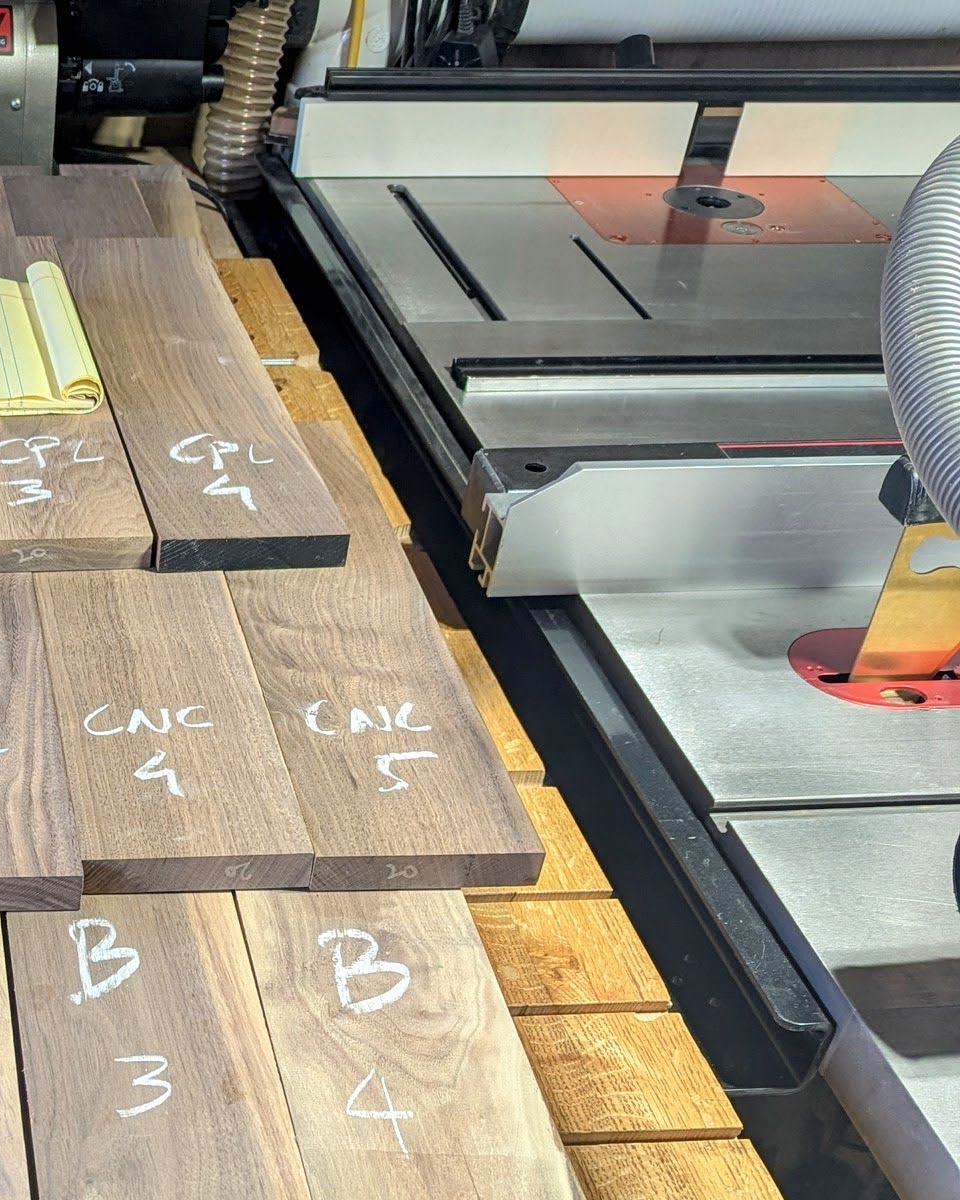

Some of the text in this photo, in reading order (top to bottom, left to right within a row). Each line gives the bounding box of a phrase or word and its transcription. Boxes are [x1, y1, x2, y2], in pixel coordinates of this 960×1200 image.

[168, 433, 274, 471] CPL
[0, 479, 52, 508] 3
[83, 704, 213, 736] CNC
[374, 750, 438, 793] 5
[69, 919, 140, 1005] B
[317, 928, 411, 1014] B
[114, 1055, 172, 1117] 3
[346, 1067, 414, 1159] 4
